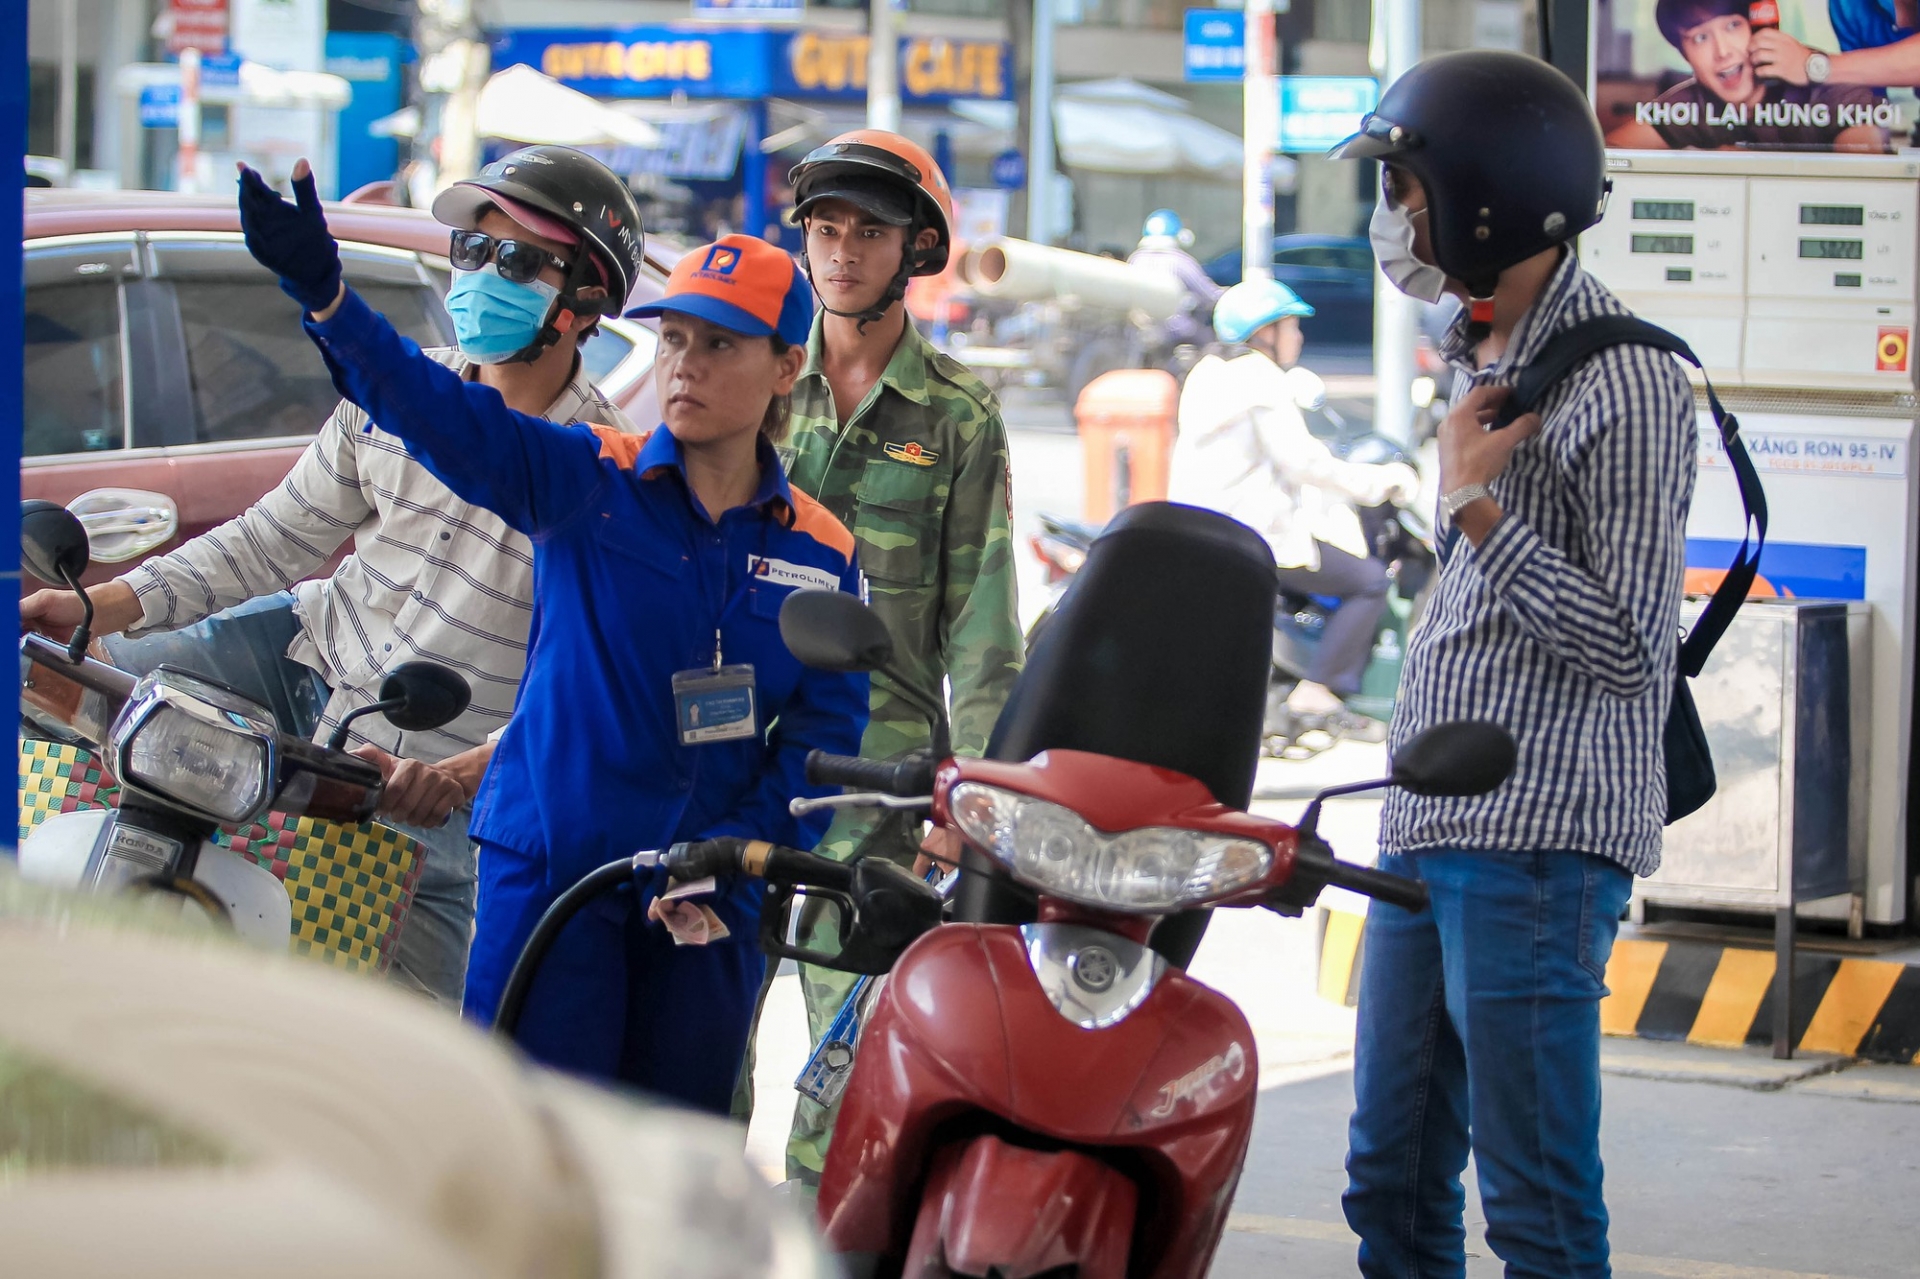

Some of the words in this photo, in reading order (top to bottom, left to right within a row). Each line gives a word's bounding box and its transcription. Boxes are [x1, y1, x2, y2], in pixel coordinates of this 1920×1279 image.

[792, 33, 870, 90] GUT
[1635, 102, 1699, 126] KHƠI
[1706, 102, 1748, 131] LẠI
[1838, 98, 1901, 127] KHỞI
[1749, 435, 1798, 455] XĂNG
[1805, 443, 1843, 457] RON
[771, 567, 836, 592] PETROLIMEX
[116, 835, 164, 858] HONDA
